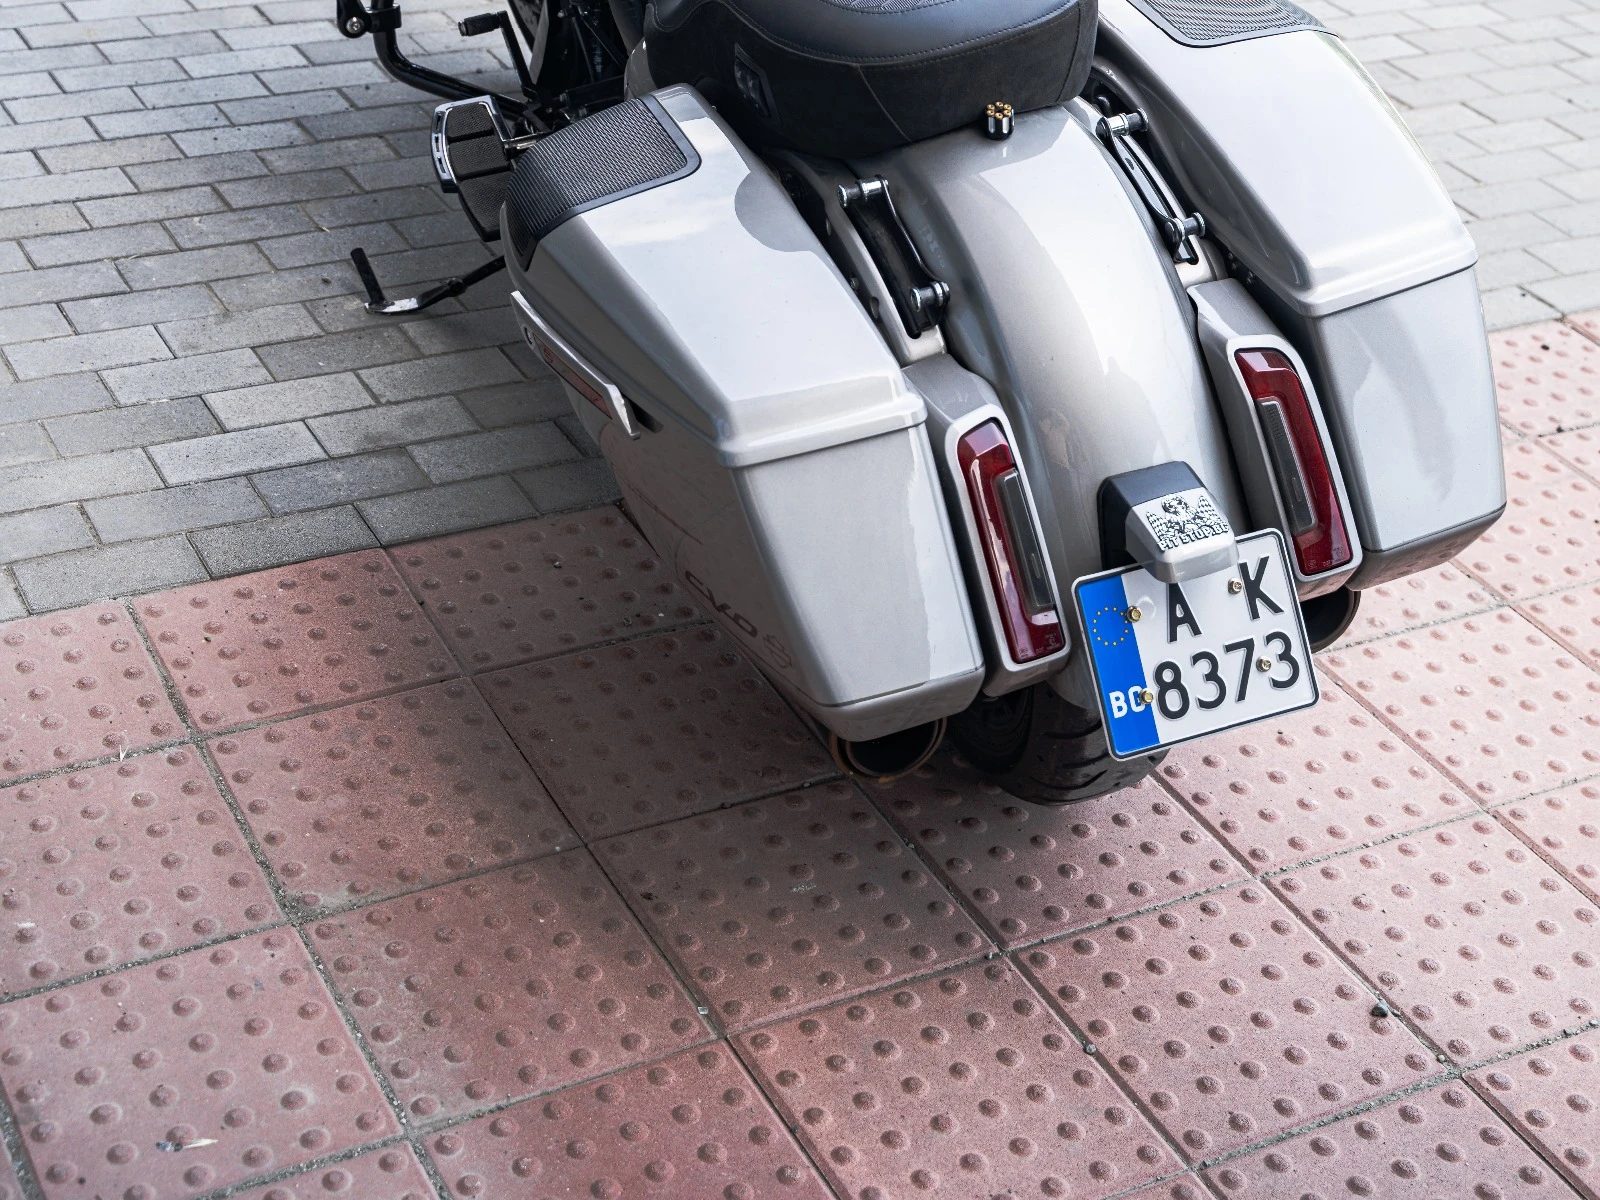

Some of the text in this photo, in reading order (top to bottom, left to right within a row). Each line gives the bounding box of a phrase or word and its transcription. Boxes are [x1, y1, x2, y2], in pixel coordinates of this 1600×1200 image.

[1157, 535, 1180, 552] PIT
[1166, 555, 1285, 644] A K
[1109, 685, 1148, 718] BG
[1153, 631, 1301, 721] 8373
